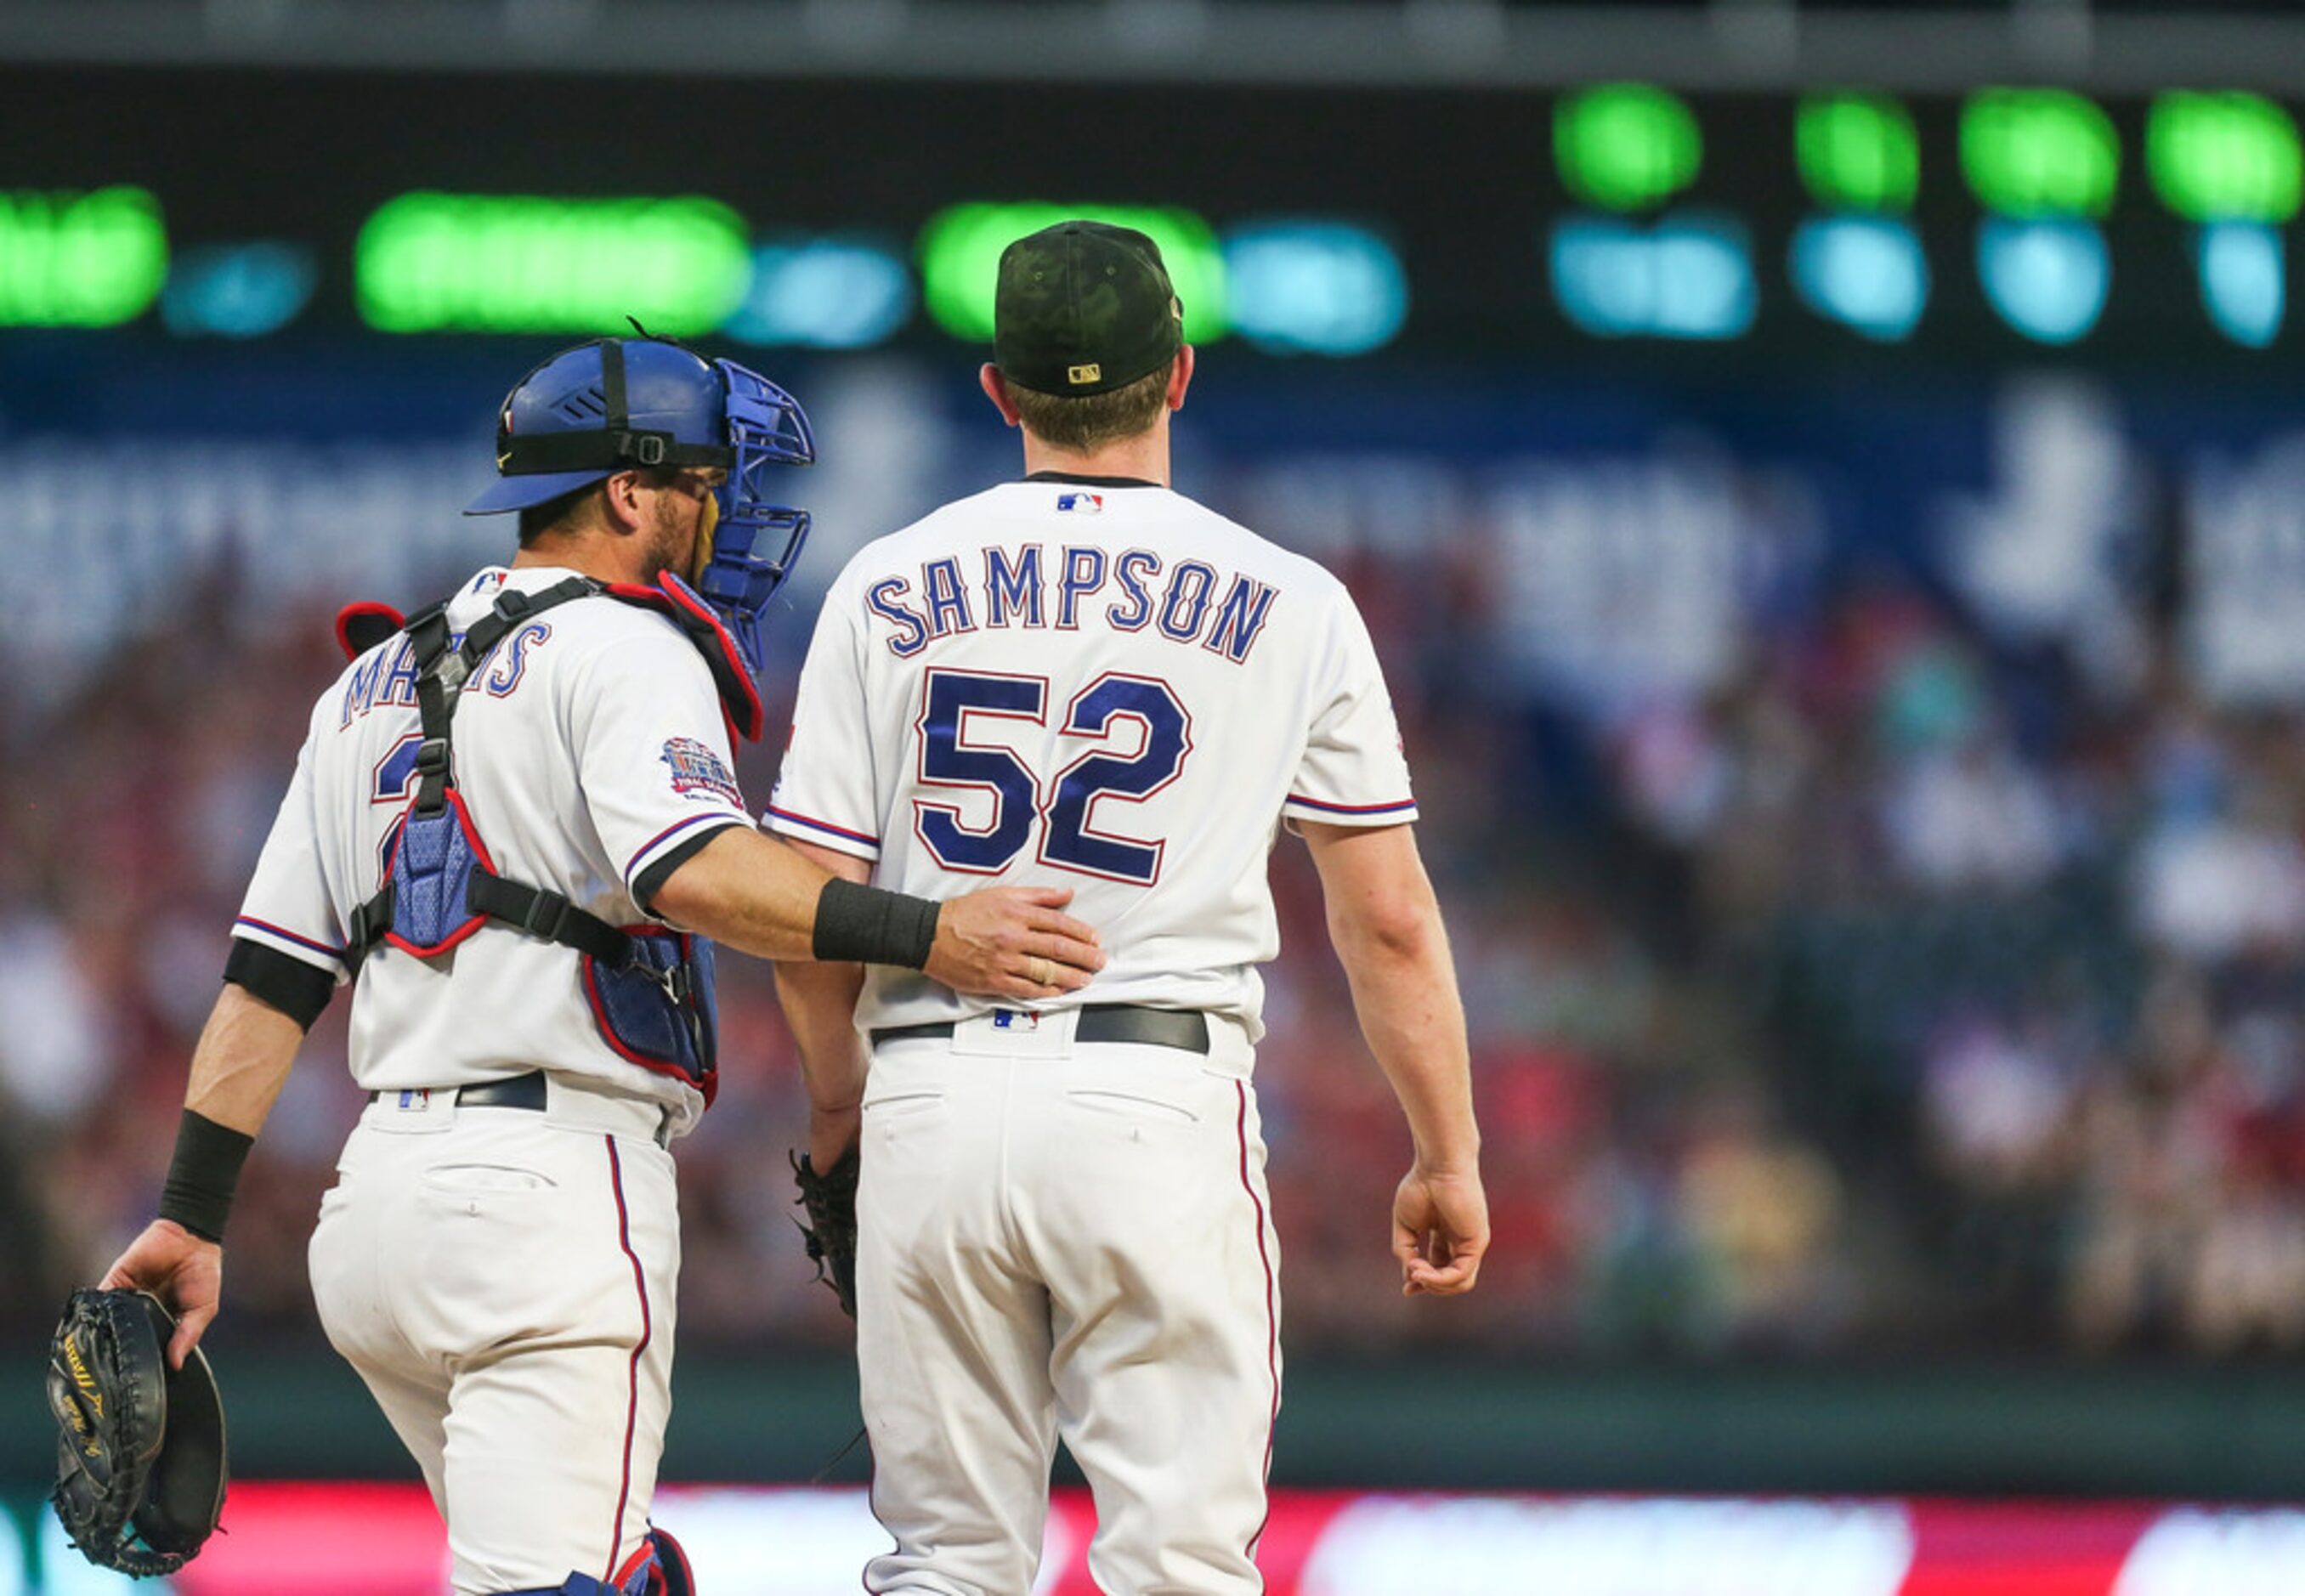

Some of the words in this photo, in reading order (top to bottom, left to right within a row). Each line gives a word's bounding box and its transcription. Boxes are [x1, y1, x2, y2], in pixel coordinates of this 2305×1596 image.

[865, 544, 1280, 665] SAMPSON
[340, 621, 552, 729] MAIS
[913, 666, 1193, 888] 52
